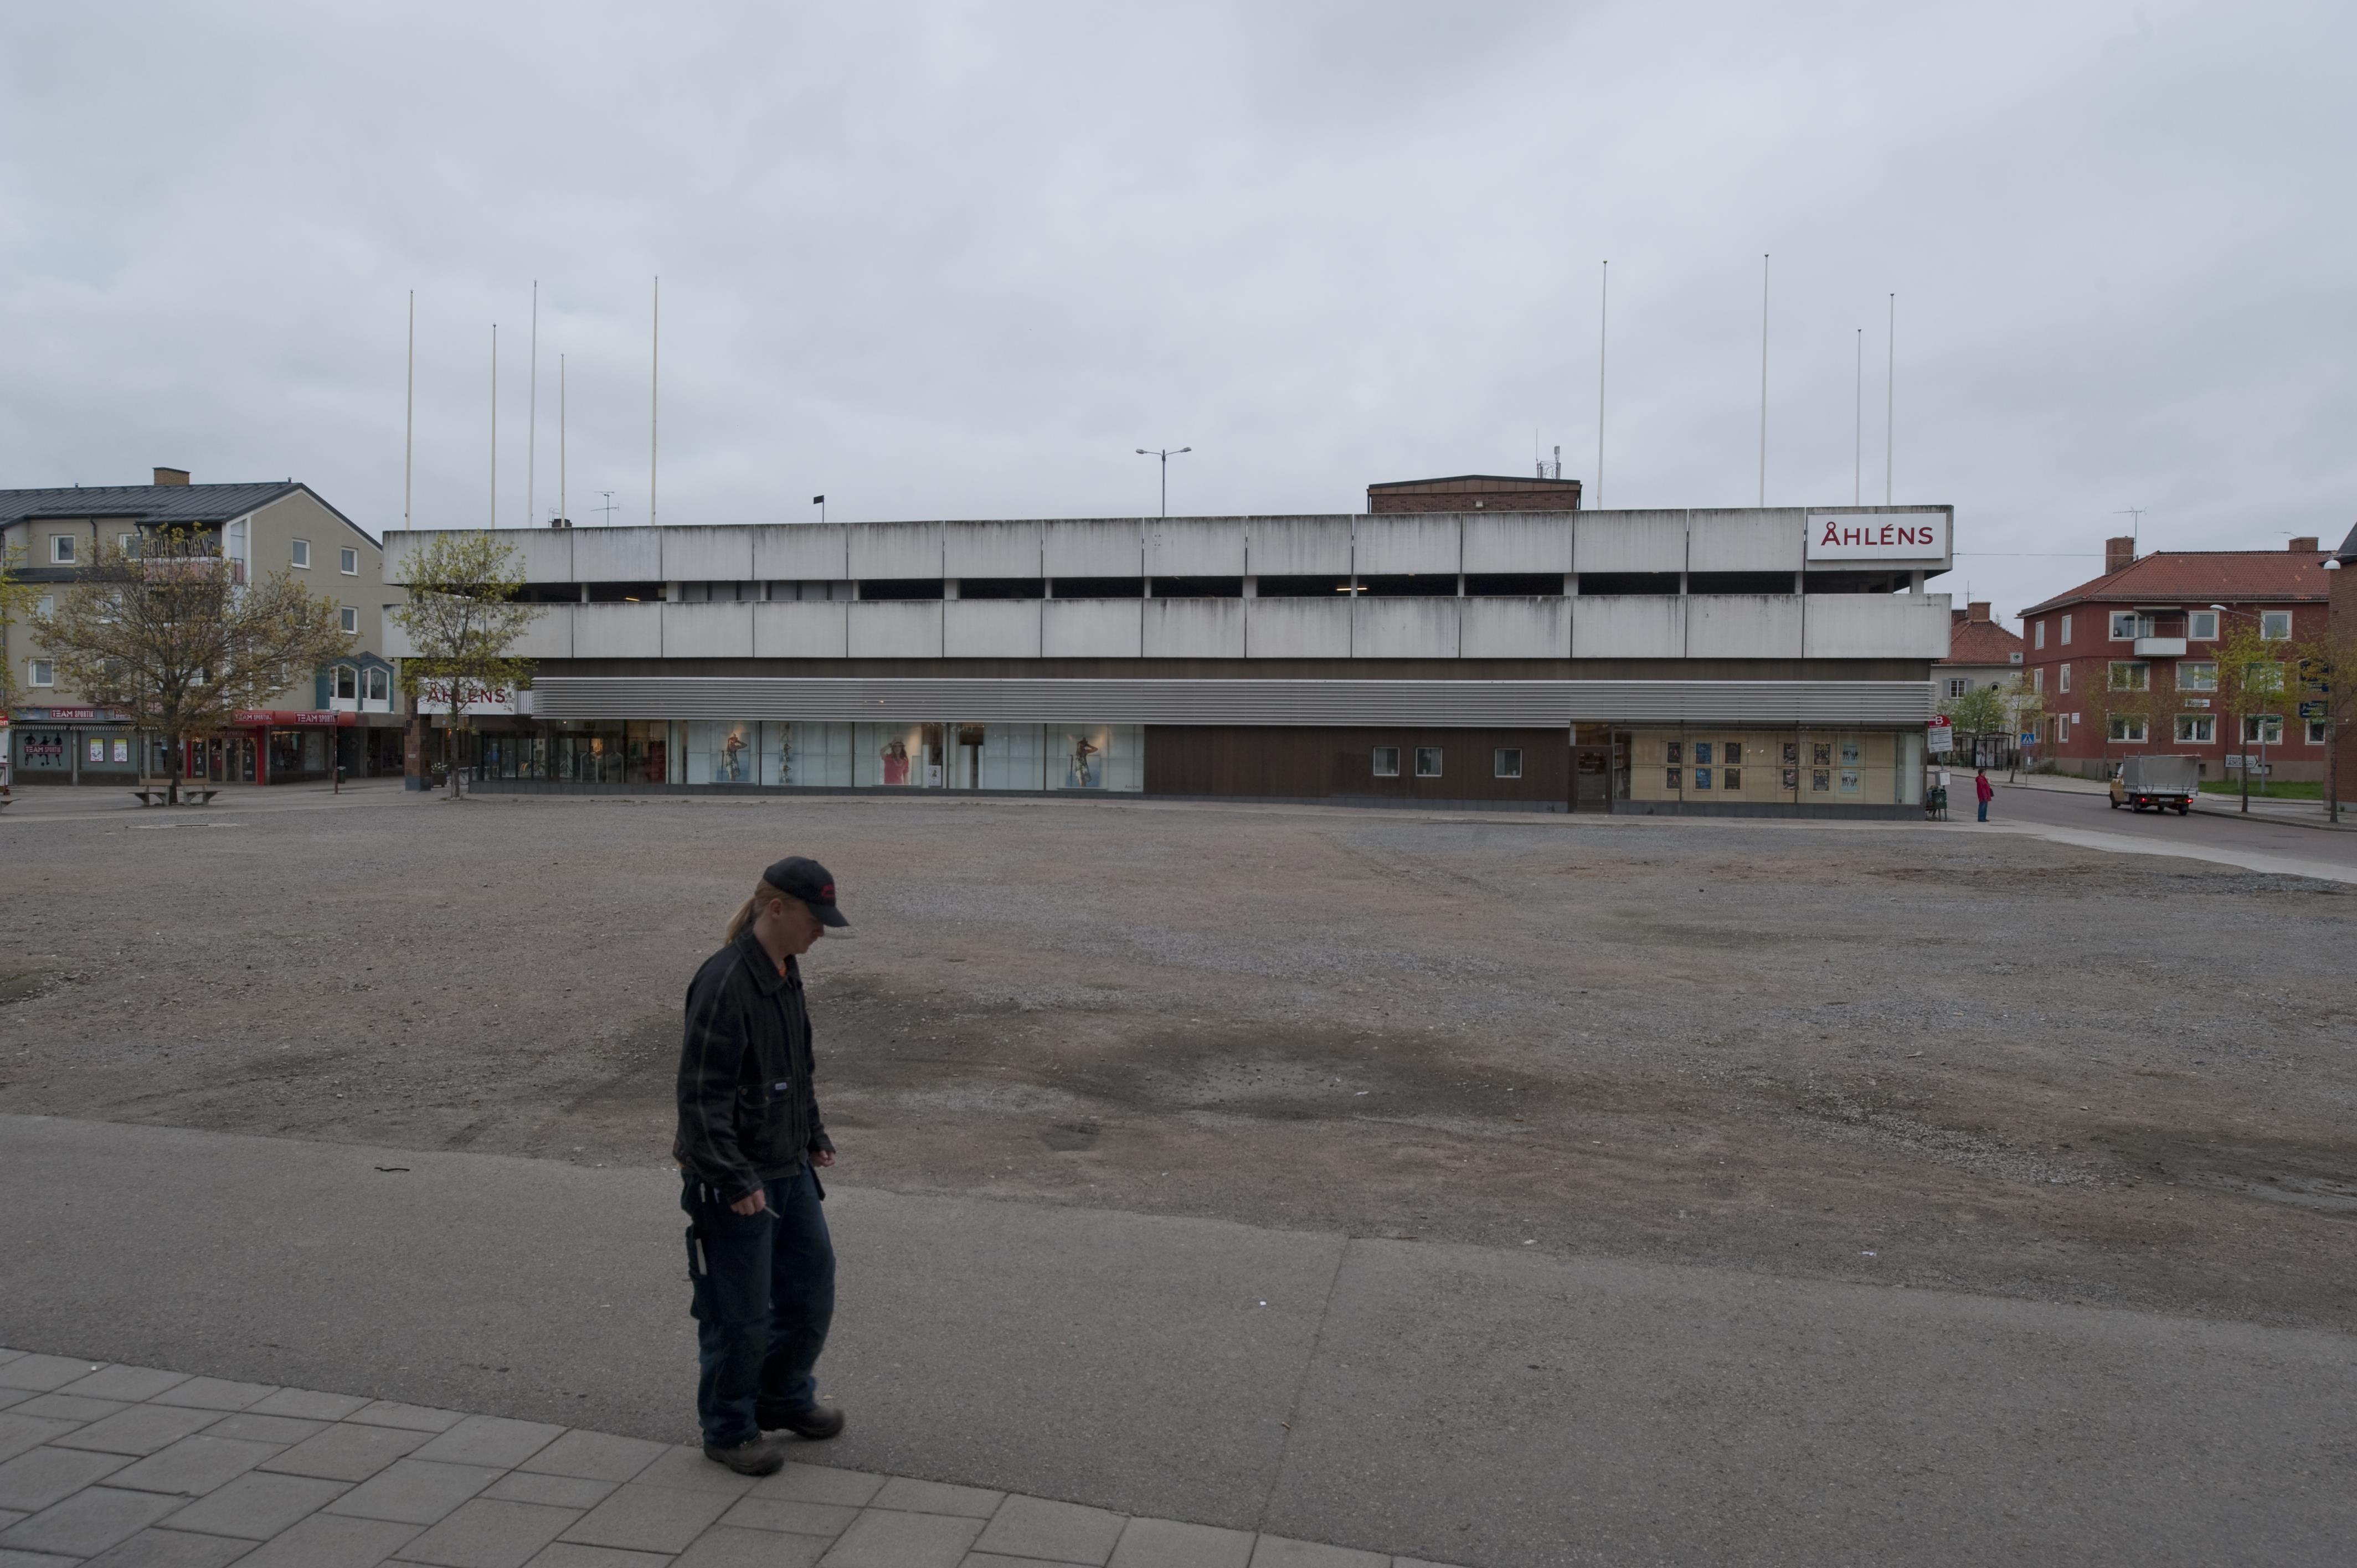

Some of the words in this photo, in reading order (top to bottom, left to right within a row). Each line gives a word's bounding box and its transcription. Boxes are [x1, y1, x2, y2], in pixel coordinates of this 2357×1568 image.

[1820, 521, 1933, 546] ÅHLÉNS
[74, 710, 94, 718] SPORTIA
[296, 714, 317, 723] TEAM
[1935, 716, 1943, 725] B
